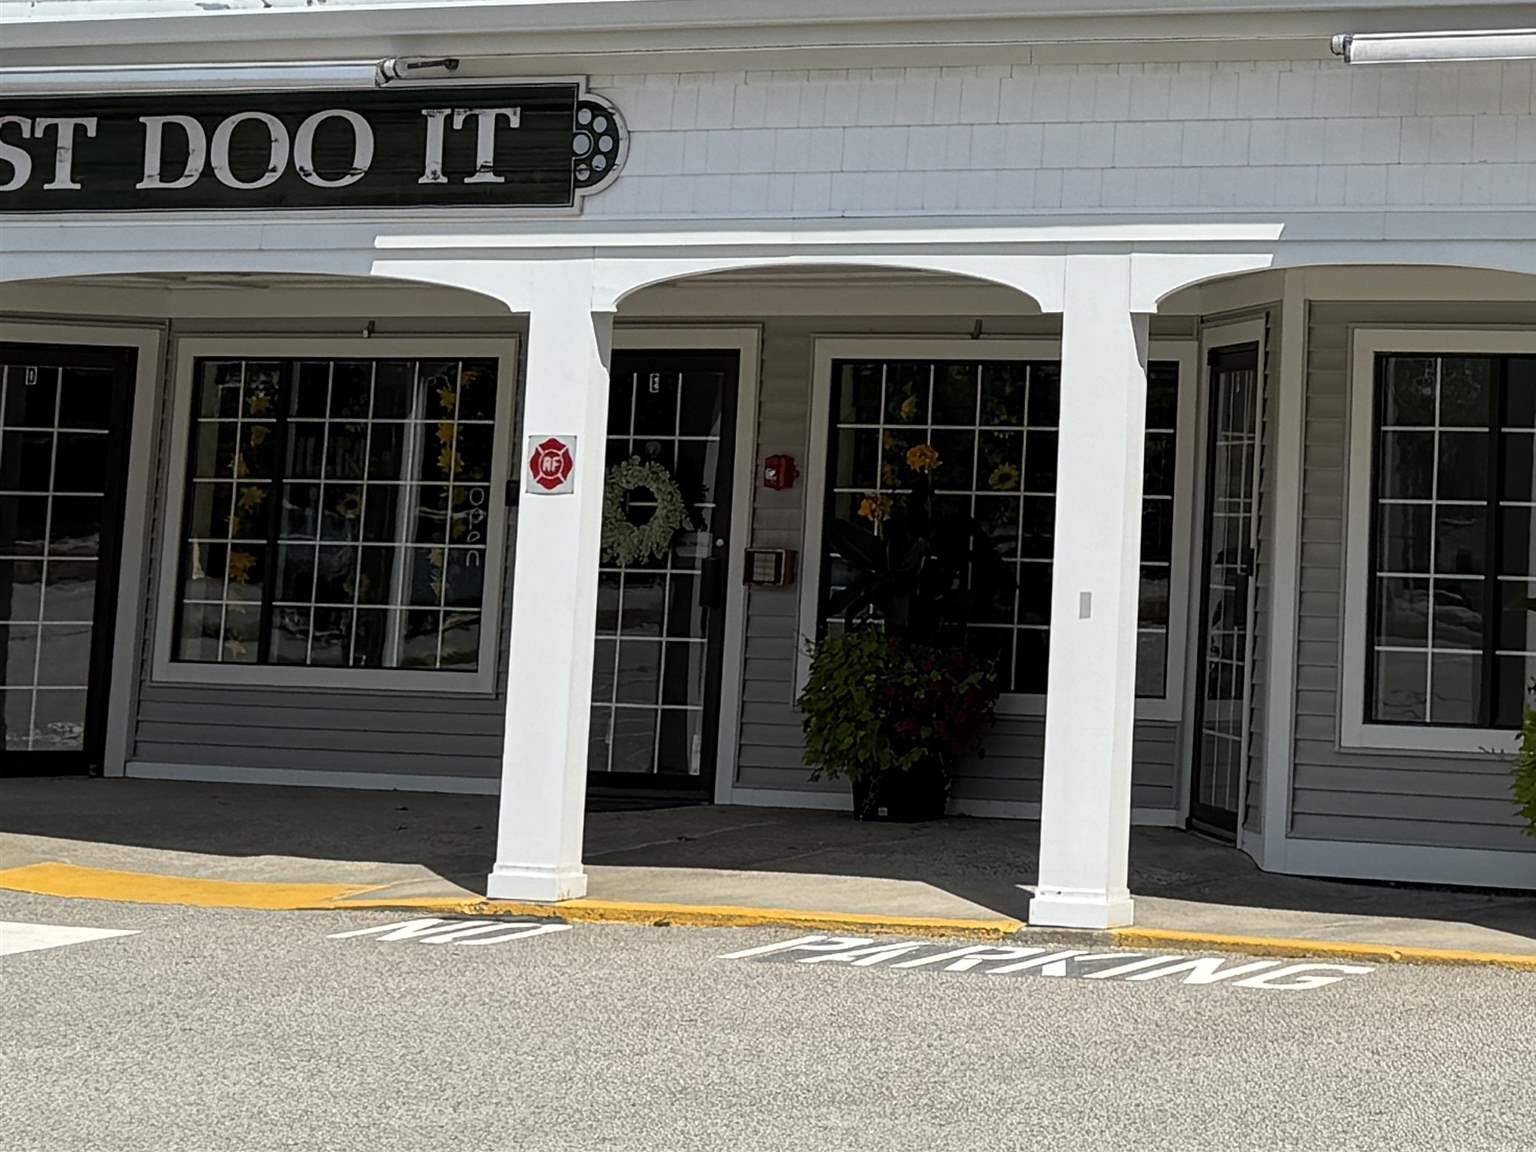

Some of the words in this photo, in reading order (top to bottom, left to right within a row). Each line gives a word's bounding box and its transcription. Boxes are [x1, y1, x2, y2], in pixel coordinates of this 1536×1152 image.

[136, 109, 375, 190] DOO
[418, 107, 521, 184] IT
[326, 918, 573, 946] NO
[717, 935, 1376, 990] PARKING
